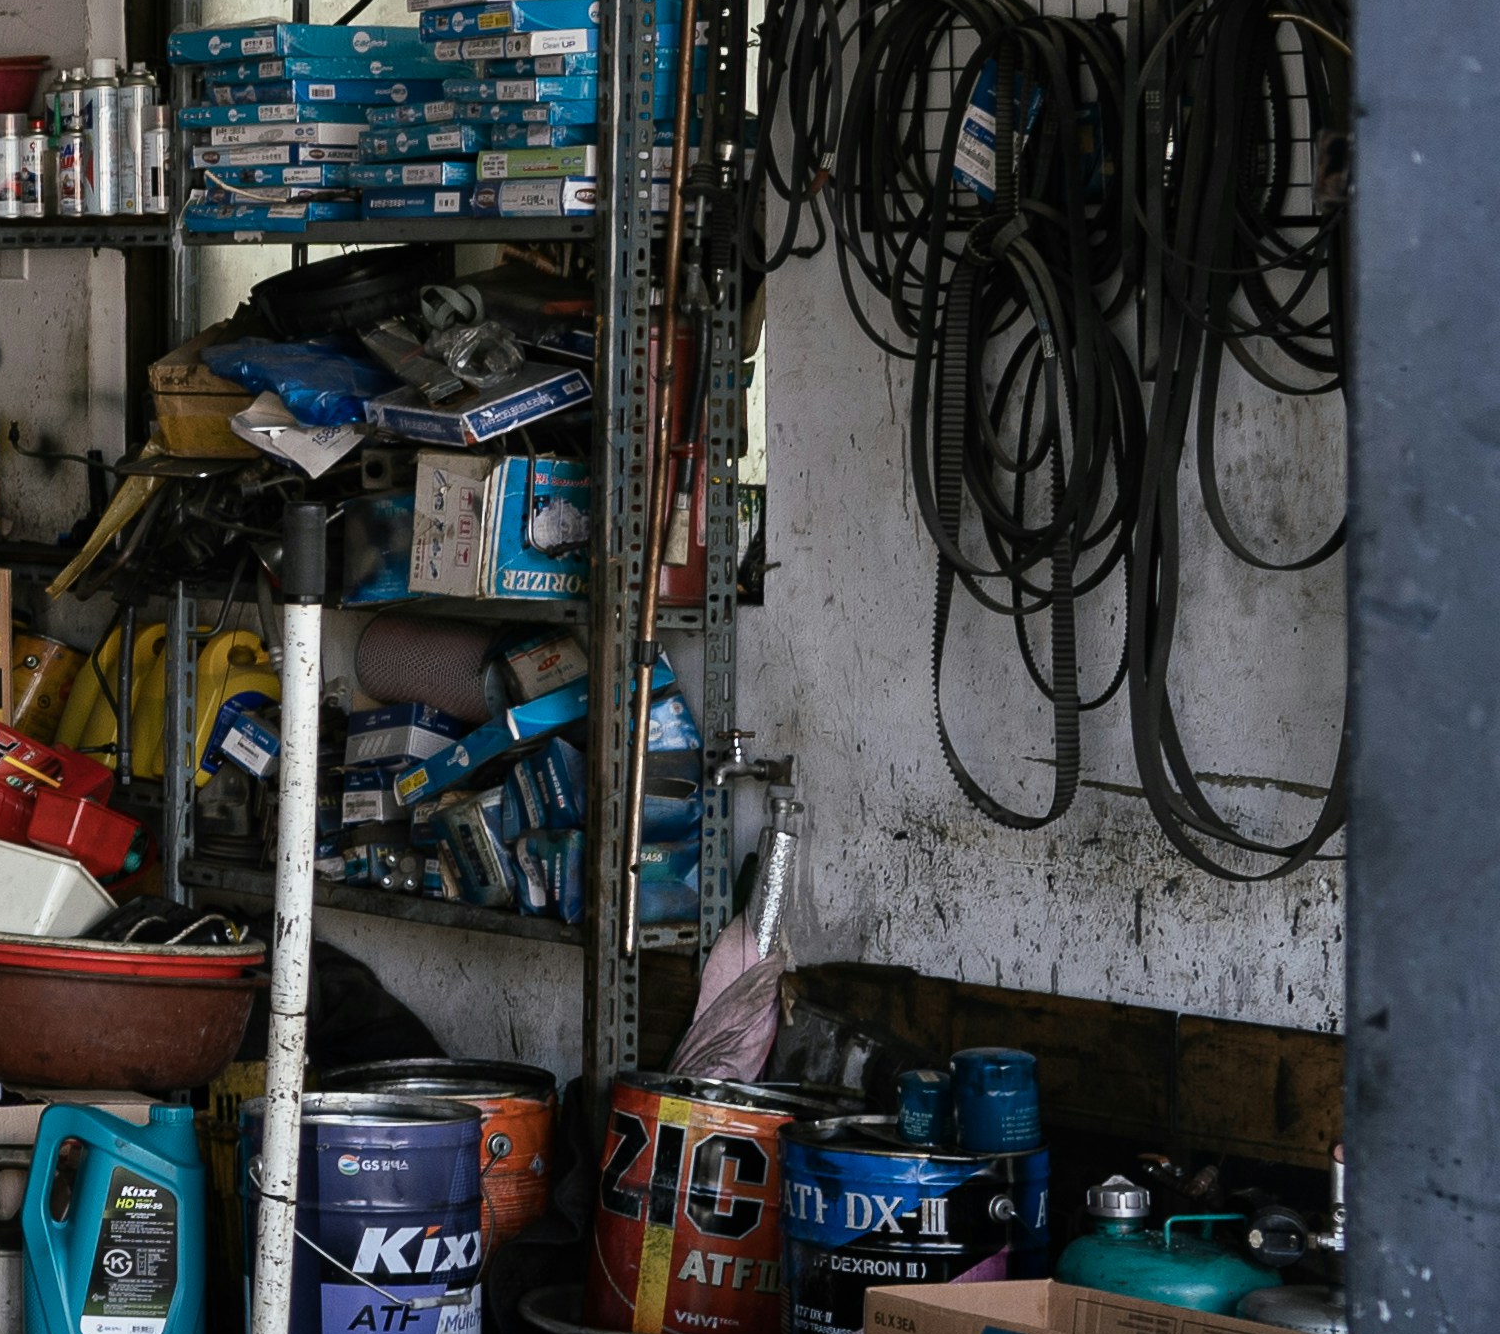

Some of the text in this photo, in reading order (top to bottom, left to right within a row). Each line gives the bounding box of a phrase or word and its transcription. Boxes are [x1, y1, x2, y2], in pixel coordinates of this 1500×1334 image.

[601, 1107, 770, 1242] ZIC
[114, 1198, 134, 1210] HD
[120, 1185, 158, 1198] Kixx
[351, 1226, 482, 1275] Kixx
[829, 1255, 900, 1280] DEXRON
